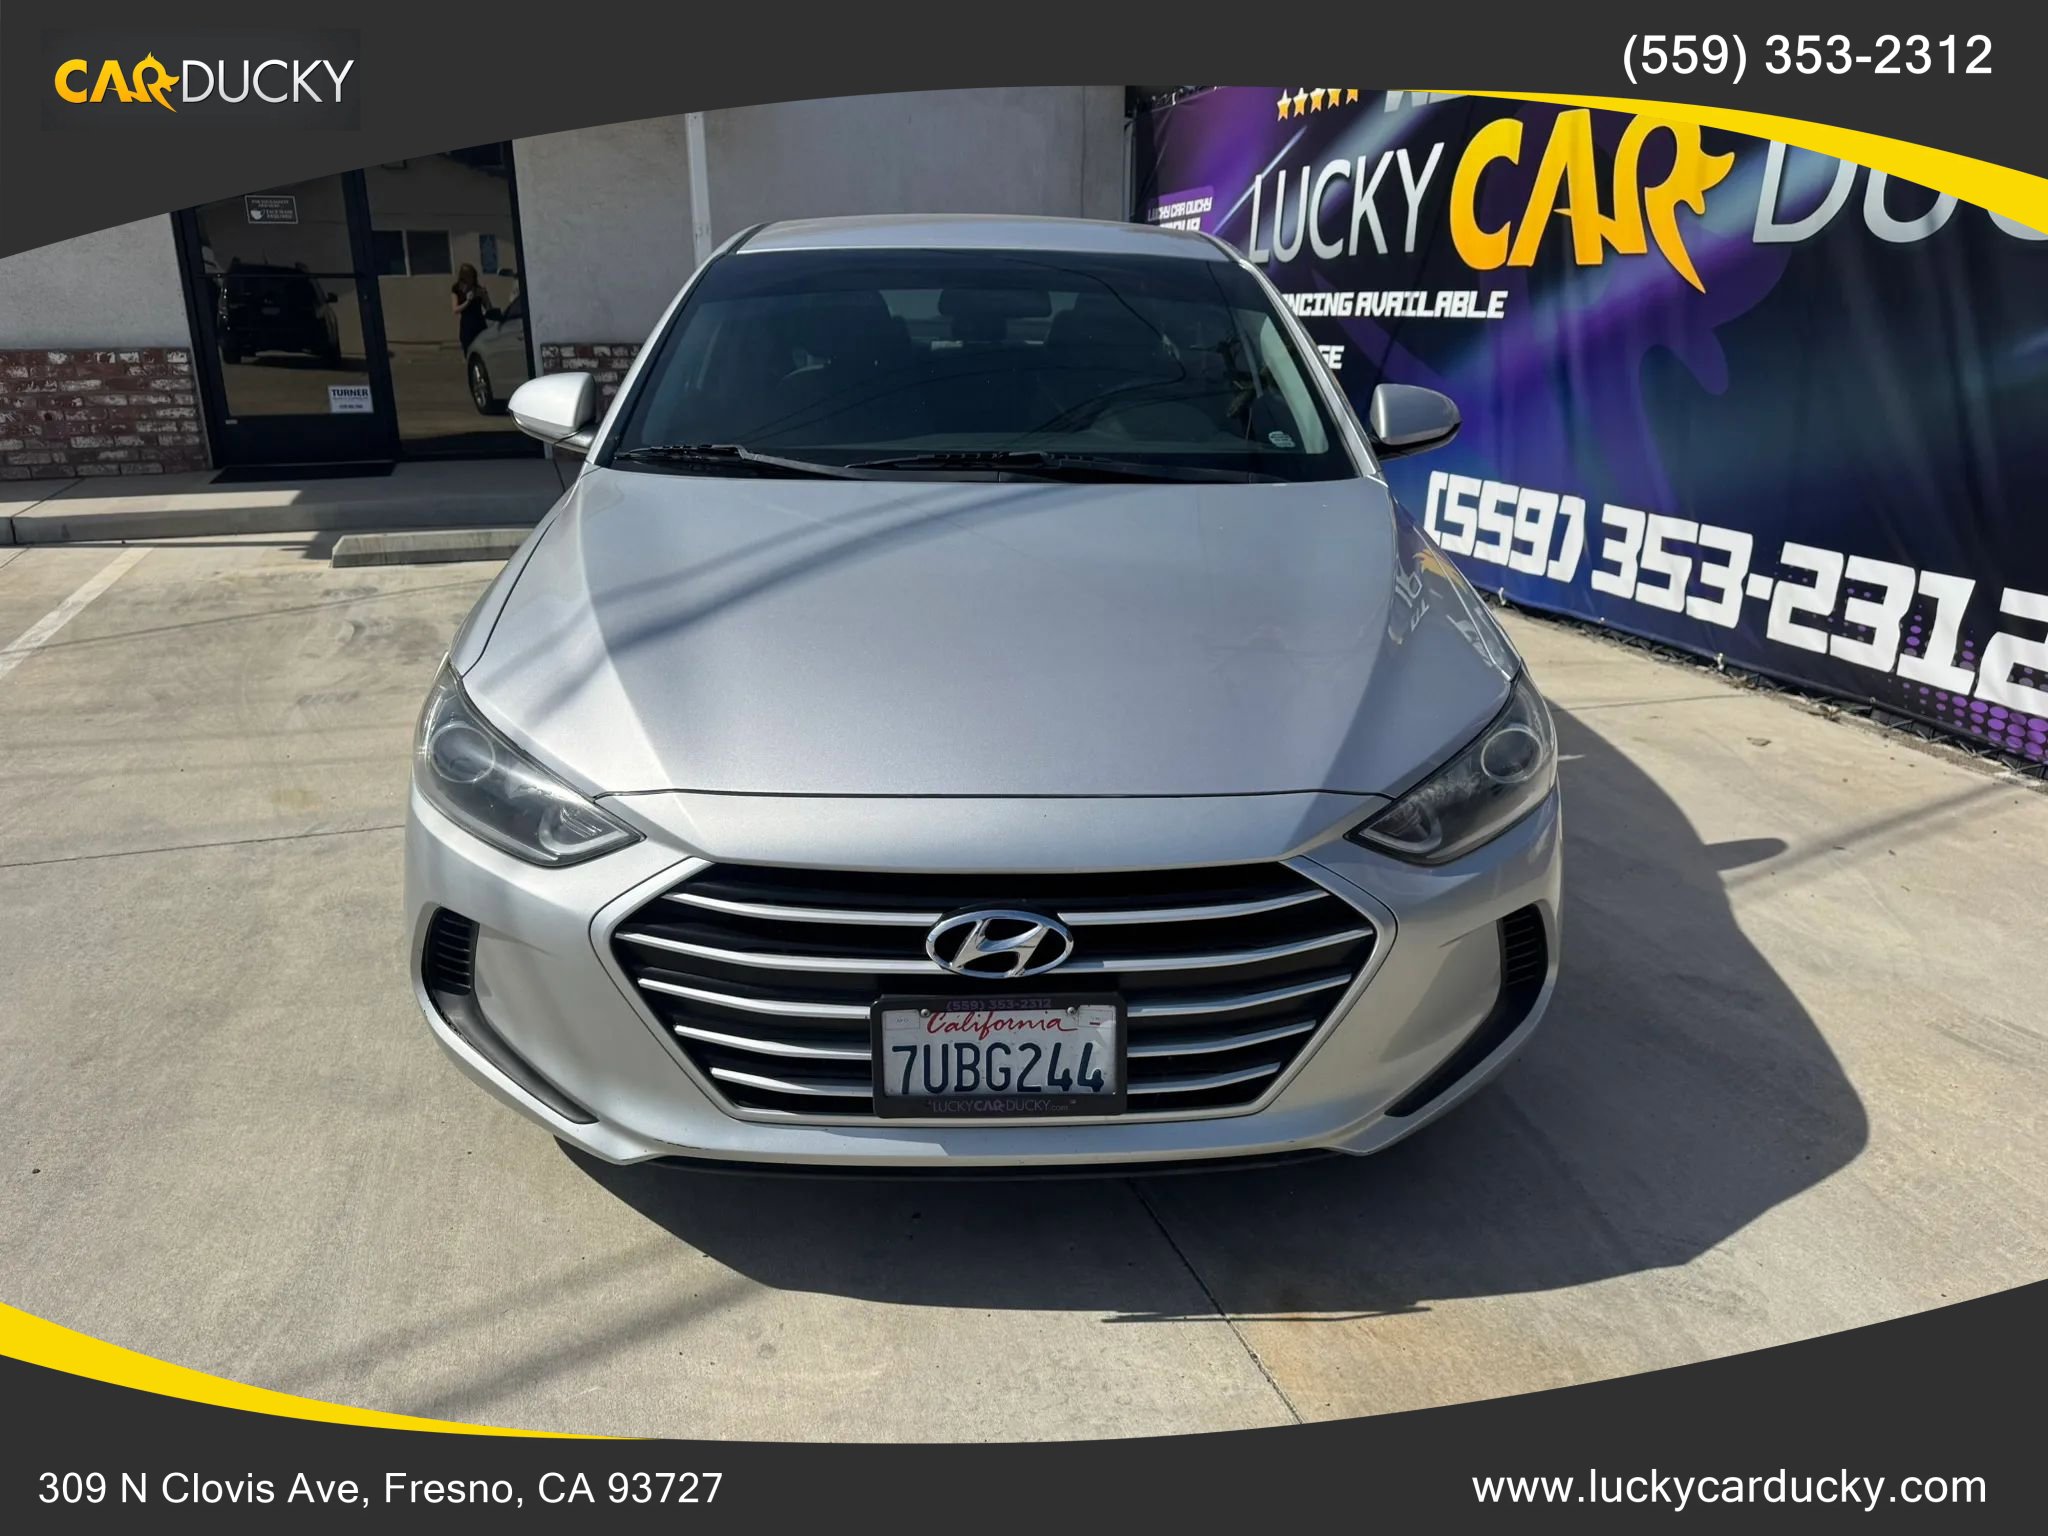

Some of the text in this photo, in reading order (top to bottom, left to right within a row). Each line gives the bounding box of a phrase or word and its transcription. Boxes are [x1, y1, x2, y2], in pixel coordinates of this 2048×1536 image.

[1186, 196, 1213, 215] DUCKY
[1248, 142, 1444, 265] LUCKY
[1449, 108, 1735, 293] CAR
[1281, 290, 1509, 319] NCING AVAILABLE
[331, 388, 369, 397] TURNER
[1424, 470, 2048, 718] (559) 353-2312
[926, 1010, 1079, 1041] California
[891, 1041, 1105, 1095] 7UBG244
